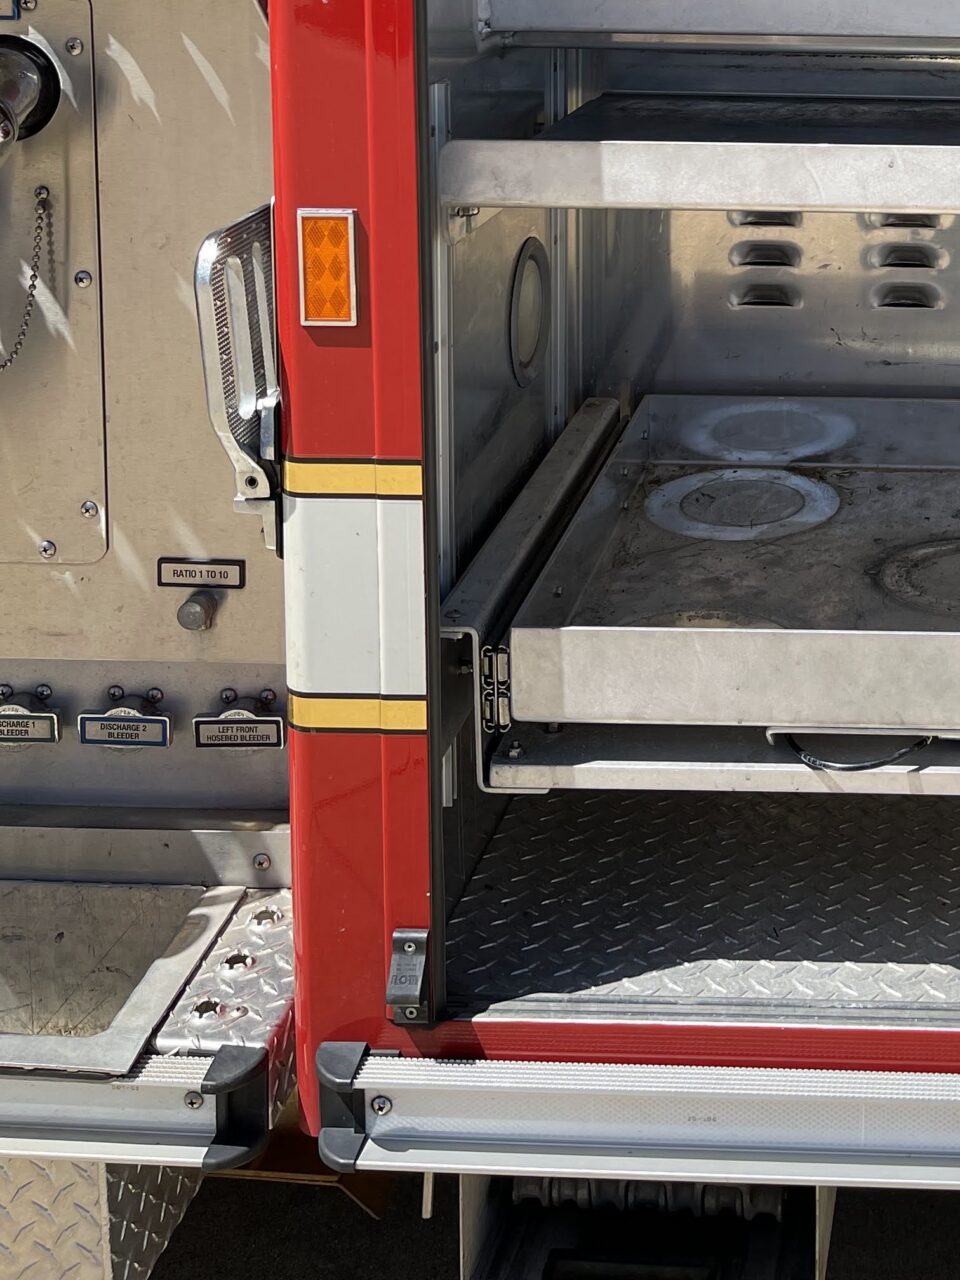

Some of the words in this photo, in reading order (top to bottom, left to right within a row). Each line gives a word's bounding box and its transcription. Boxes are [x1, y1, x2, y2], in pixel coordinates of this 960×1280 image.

[173, 569, 197, 579] RATIO
[206, 569, 216, 579] TO
[219, 569, 229, 579] 10
[100, 723, 140, 731] DISCHARGE
[206, 734, 239, 742] HOSEBED
[240, 734, 271, 742] BLEEDER
